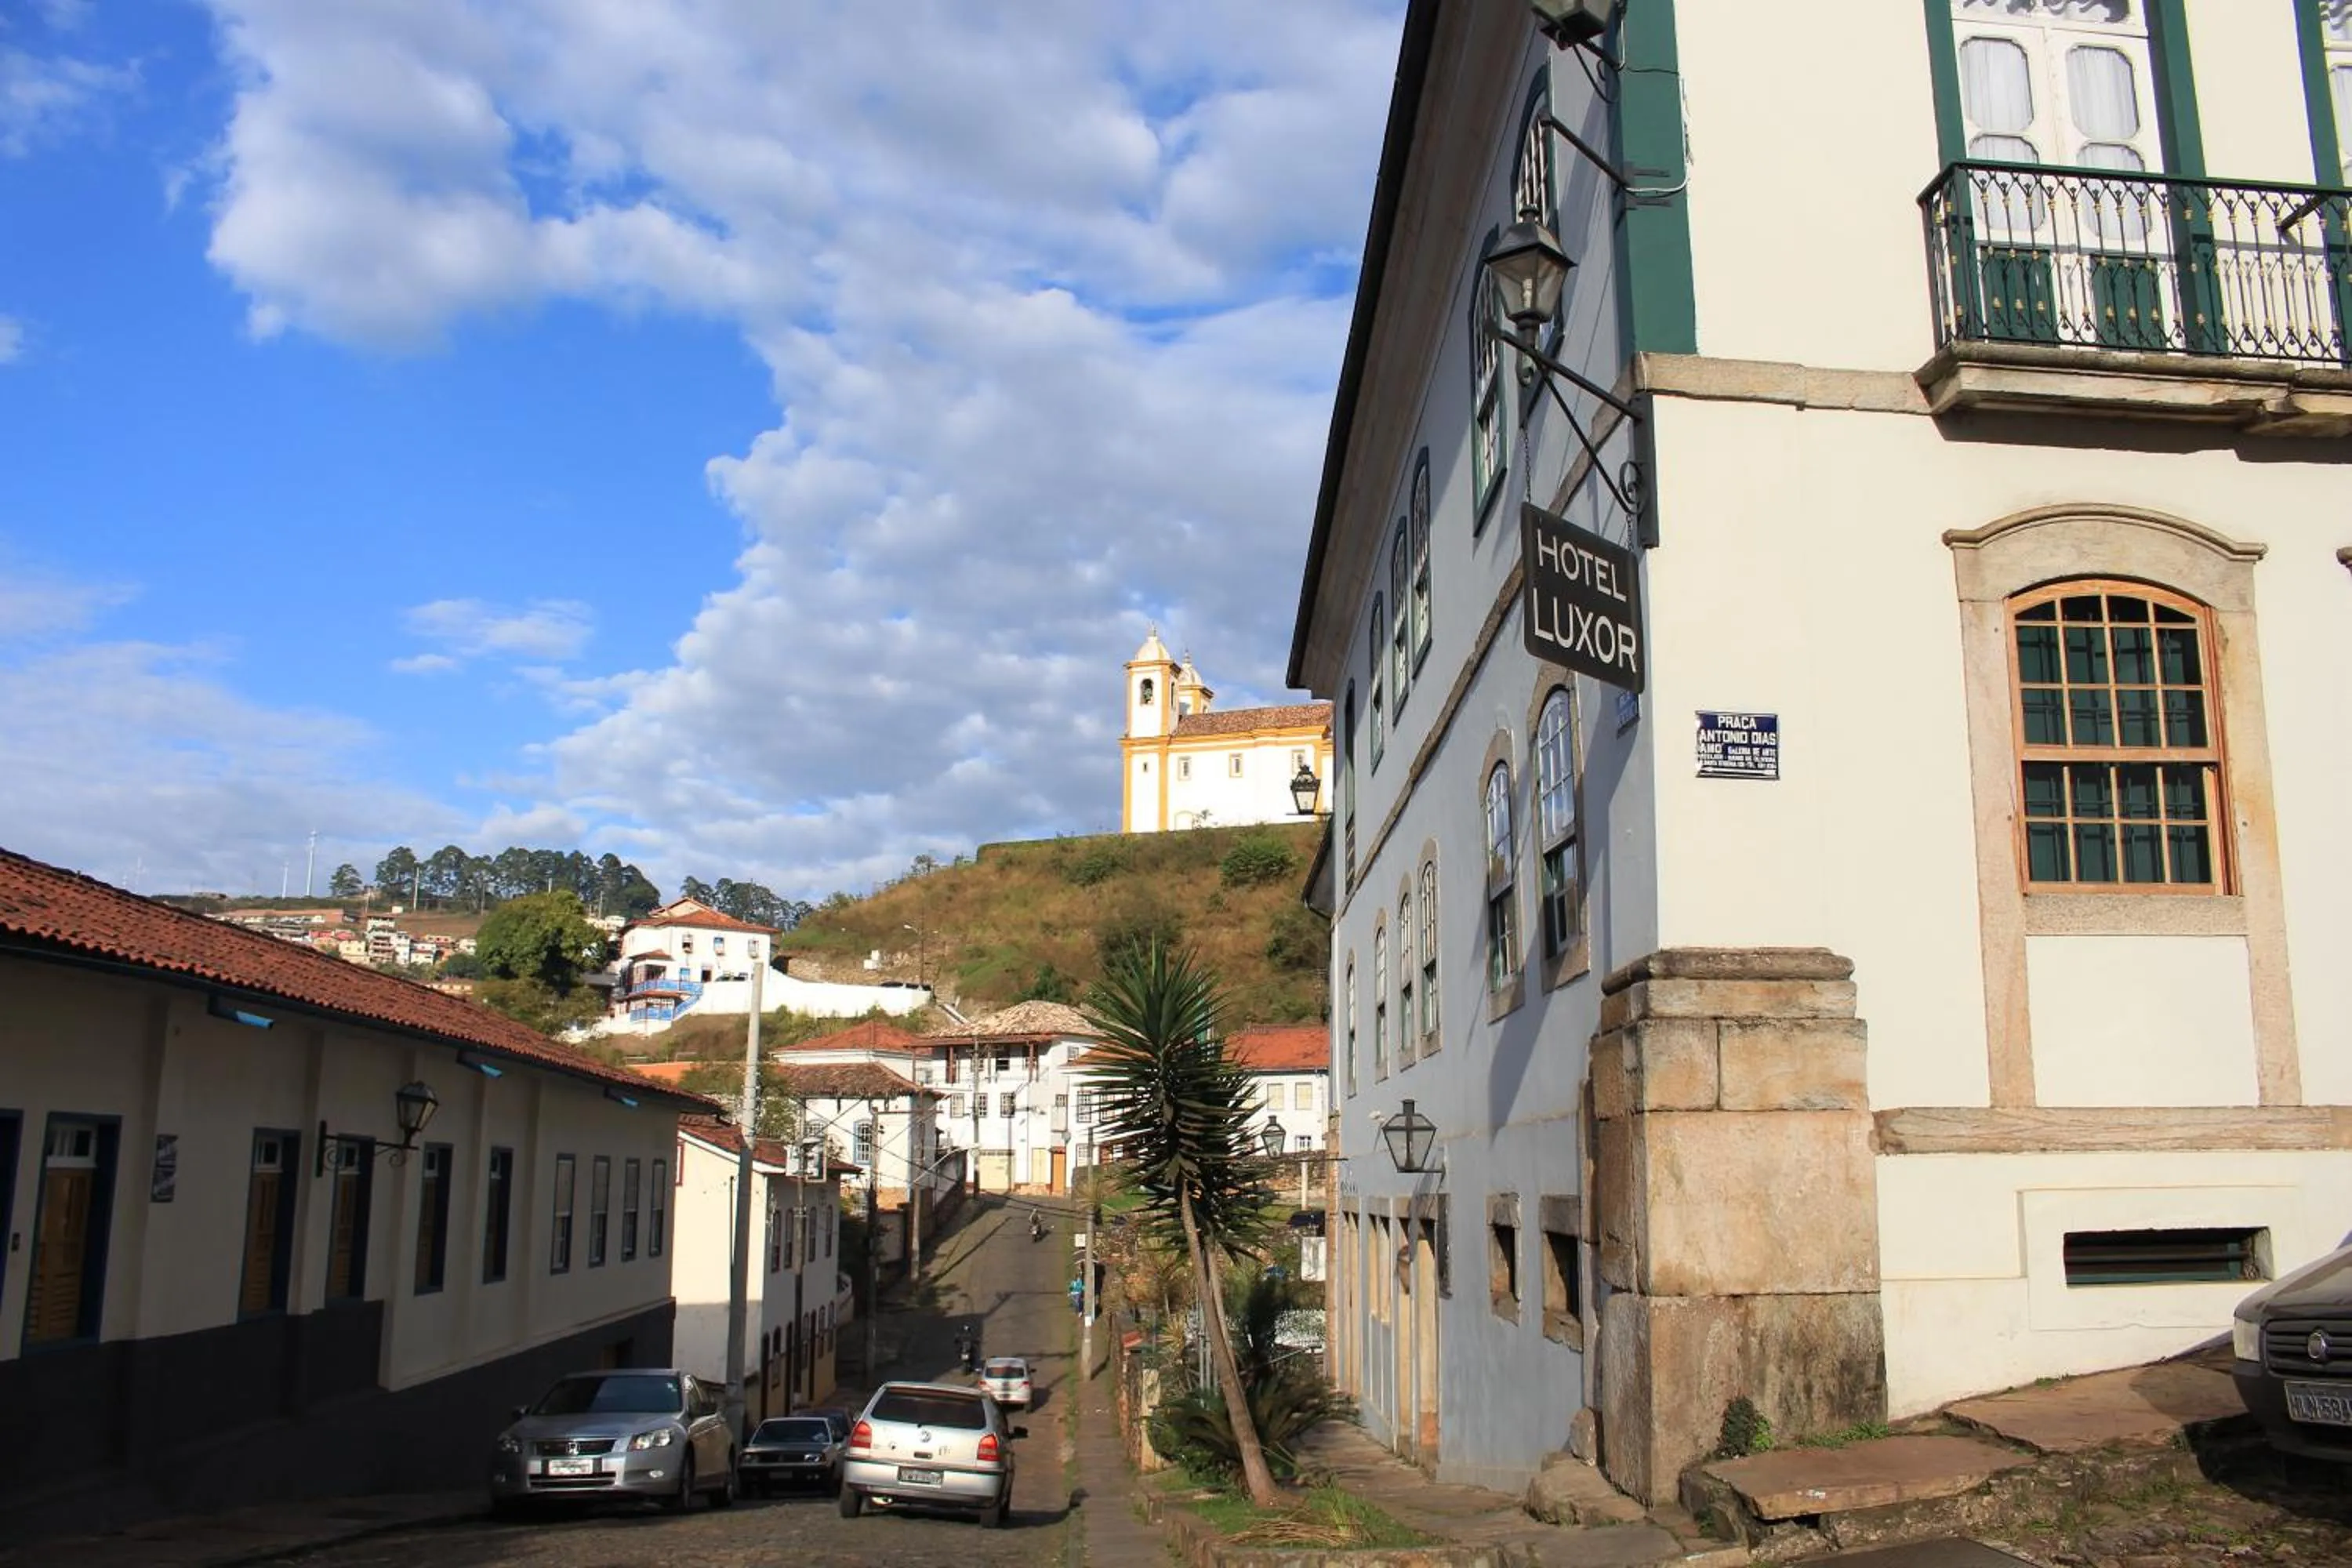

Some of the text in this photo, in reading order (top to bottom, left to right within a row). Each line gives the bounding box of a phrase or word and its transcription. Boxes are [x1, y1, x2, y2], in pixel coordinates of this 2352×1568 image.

[1537, 528, 1627, 602] HOTEL
[1533, 588, 1636, 673] LUXOR
[1700, 729, 1776, 745] ANTONIO DIAS
